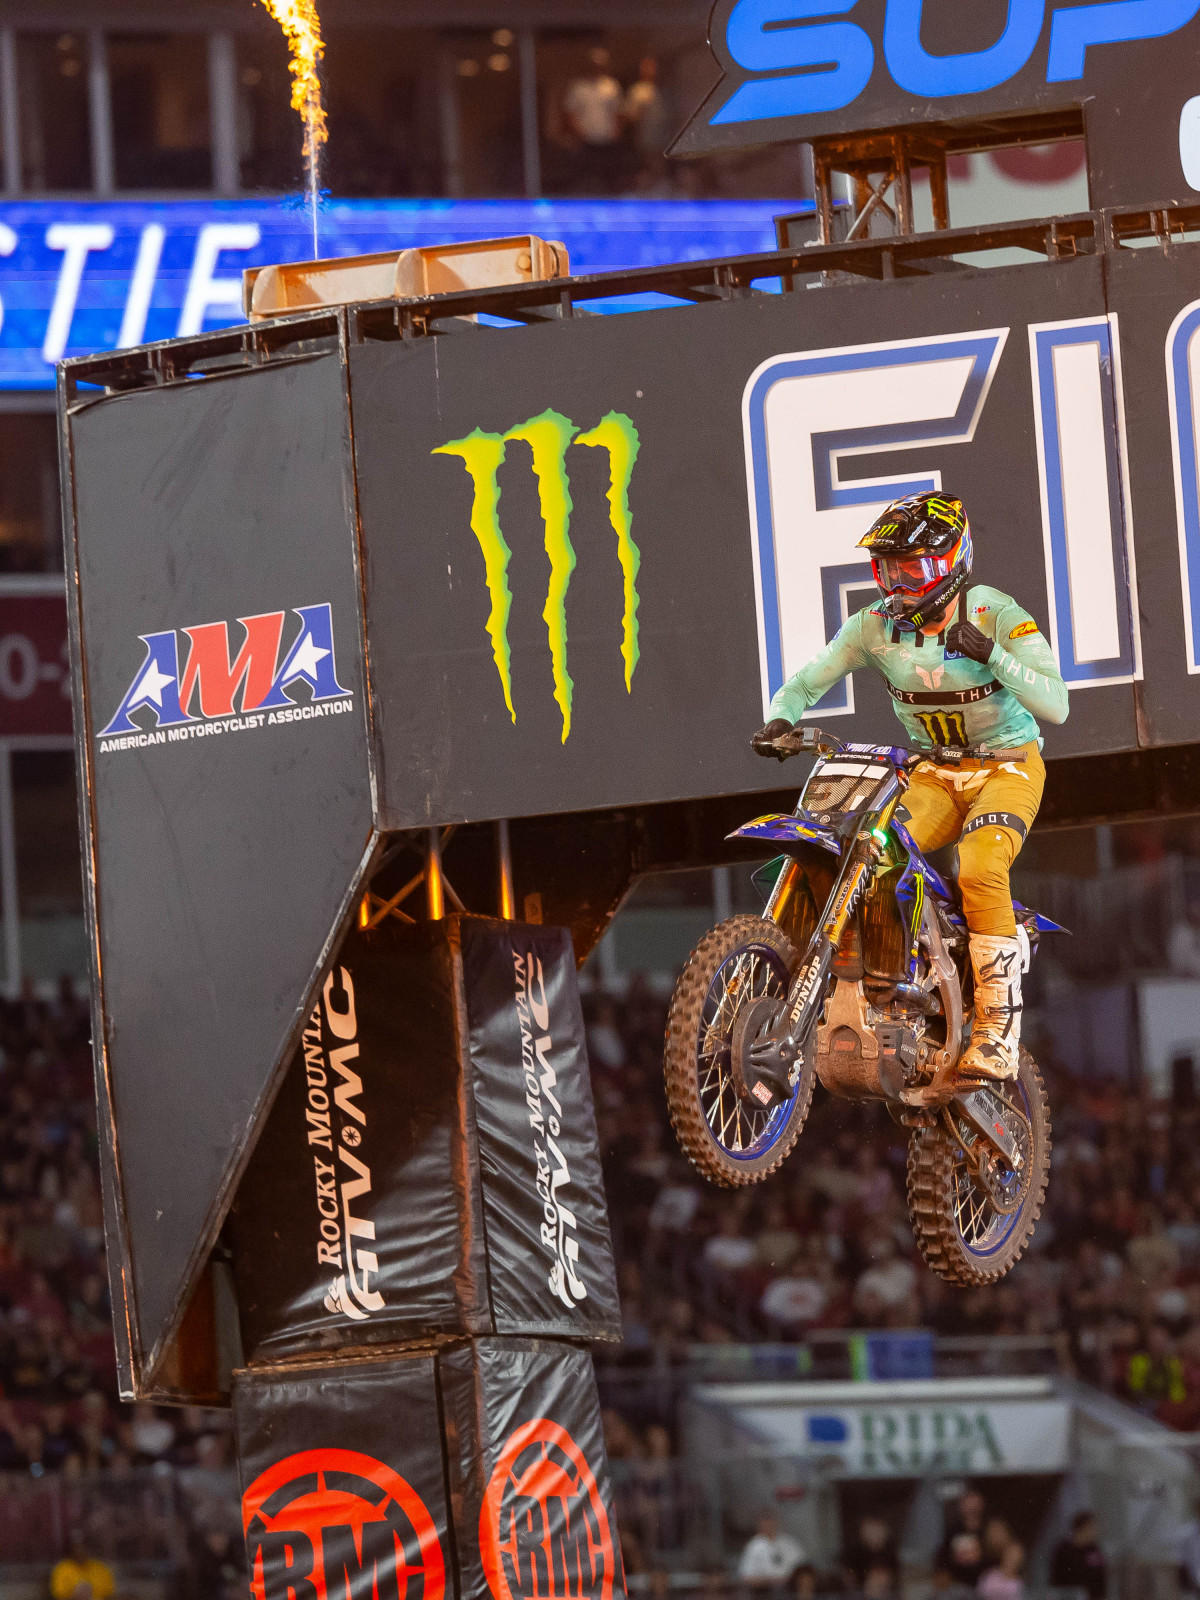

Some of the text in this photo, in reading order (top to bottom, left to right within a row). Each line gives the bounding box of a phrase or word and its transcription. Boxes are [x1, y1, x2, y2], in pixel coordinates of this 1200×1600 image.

[96, 602, 354, 738] AMA
[100, 700, 353, 753] AMERICAN MOTORCYCLIST ASSOCIATION
[966, 814, 1009, 832] THOR
[790, 956, 821, 1024] DUNLOP
[512, 950, 558, 1252] ROCKY MOUNTAIN
[314, 1156, 342, 1269] ROCKY
